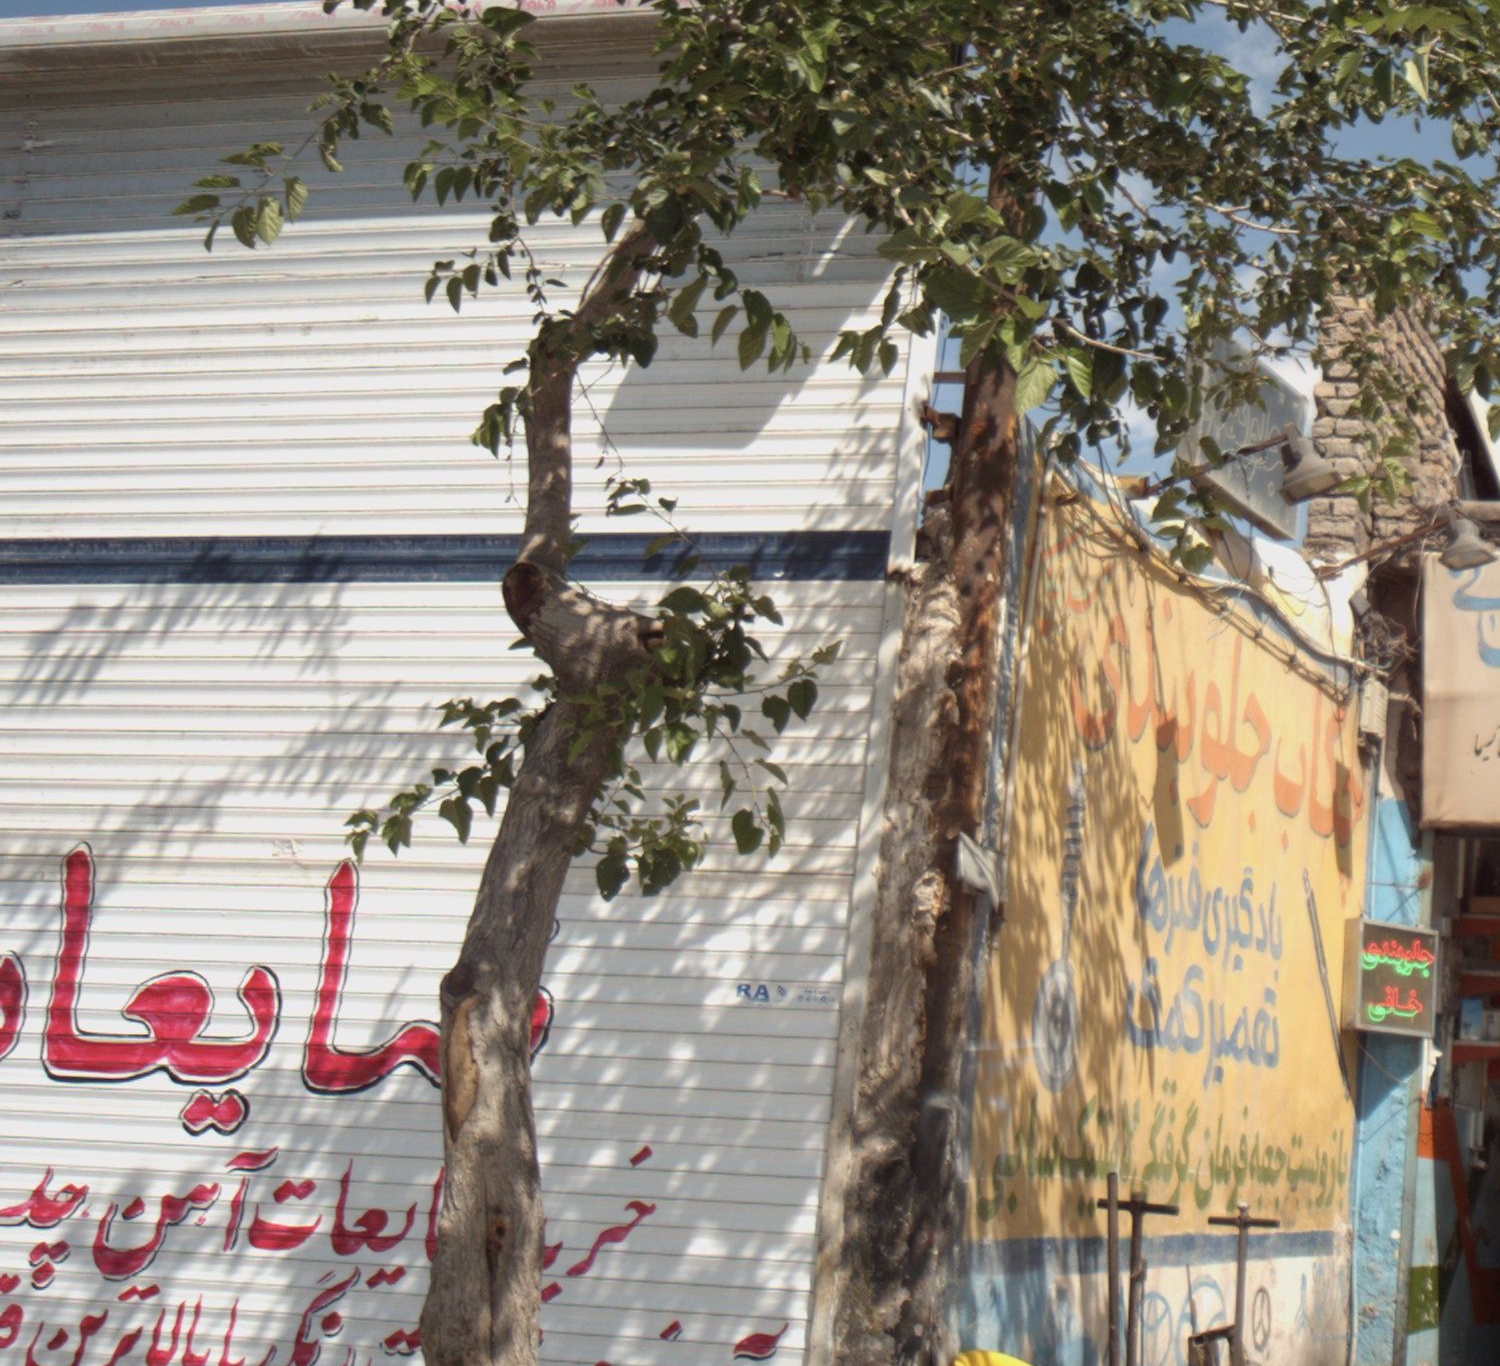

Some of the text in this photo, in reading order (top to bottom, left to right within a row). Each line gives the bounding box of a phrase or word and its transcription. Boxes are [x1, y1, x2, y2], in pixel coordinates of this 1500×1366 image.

[1361, 938, 1437, 978] جلوبندی
[1202, 986, 1280, 1091] تعمیر
[1367, 985, 1424, 1023] خانی
[93, 1146, 279, 1280] آهن
